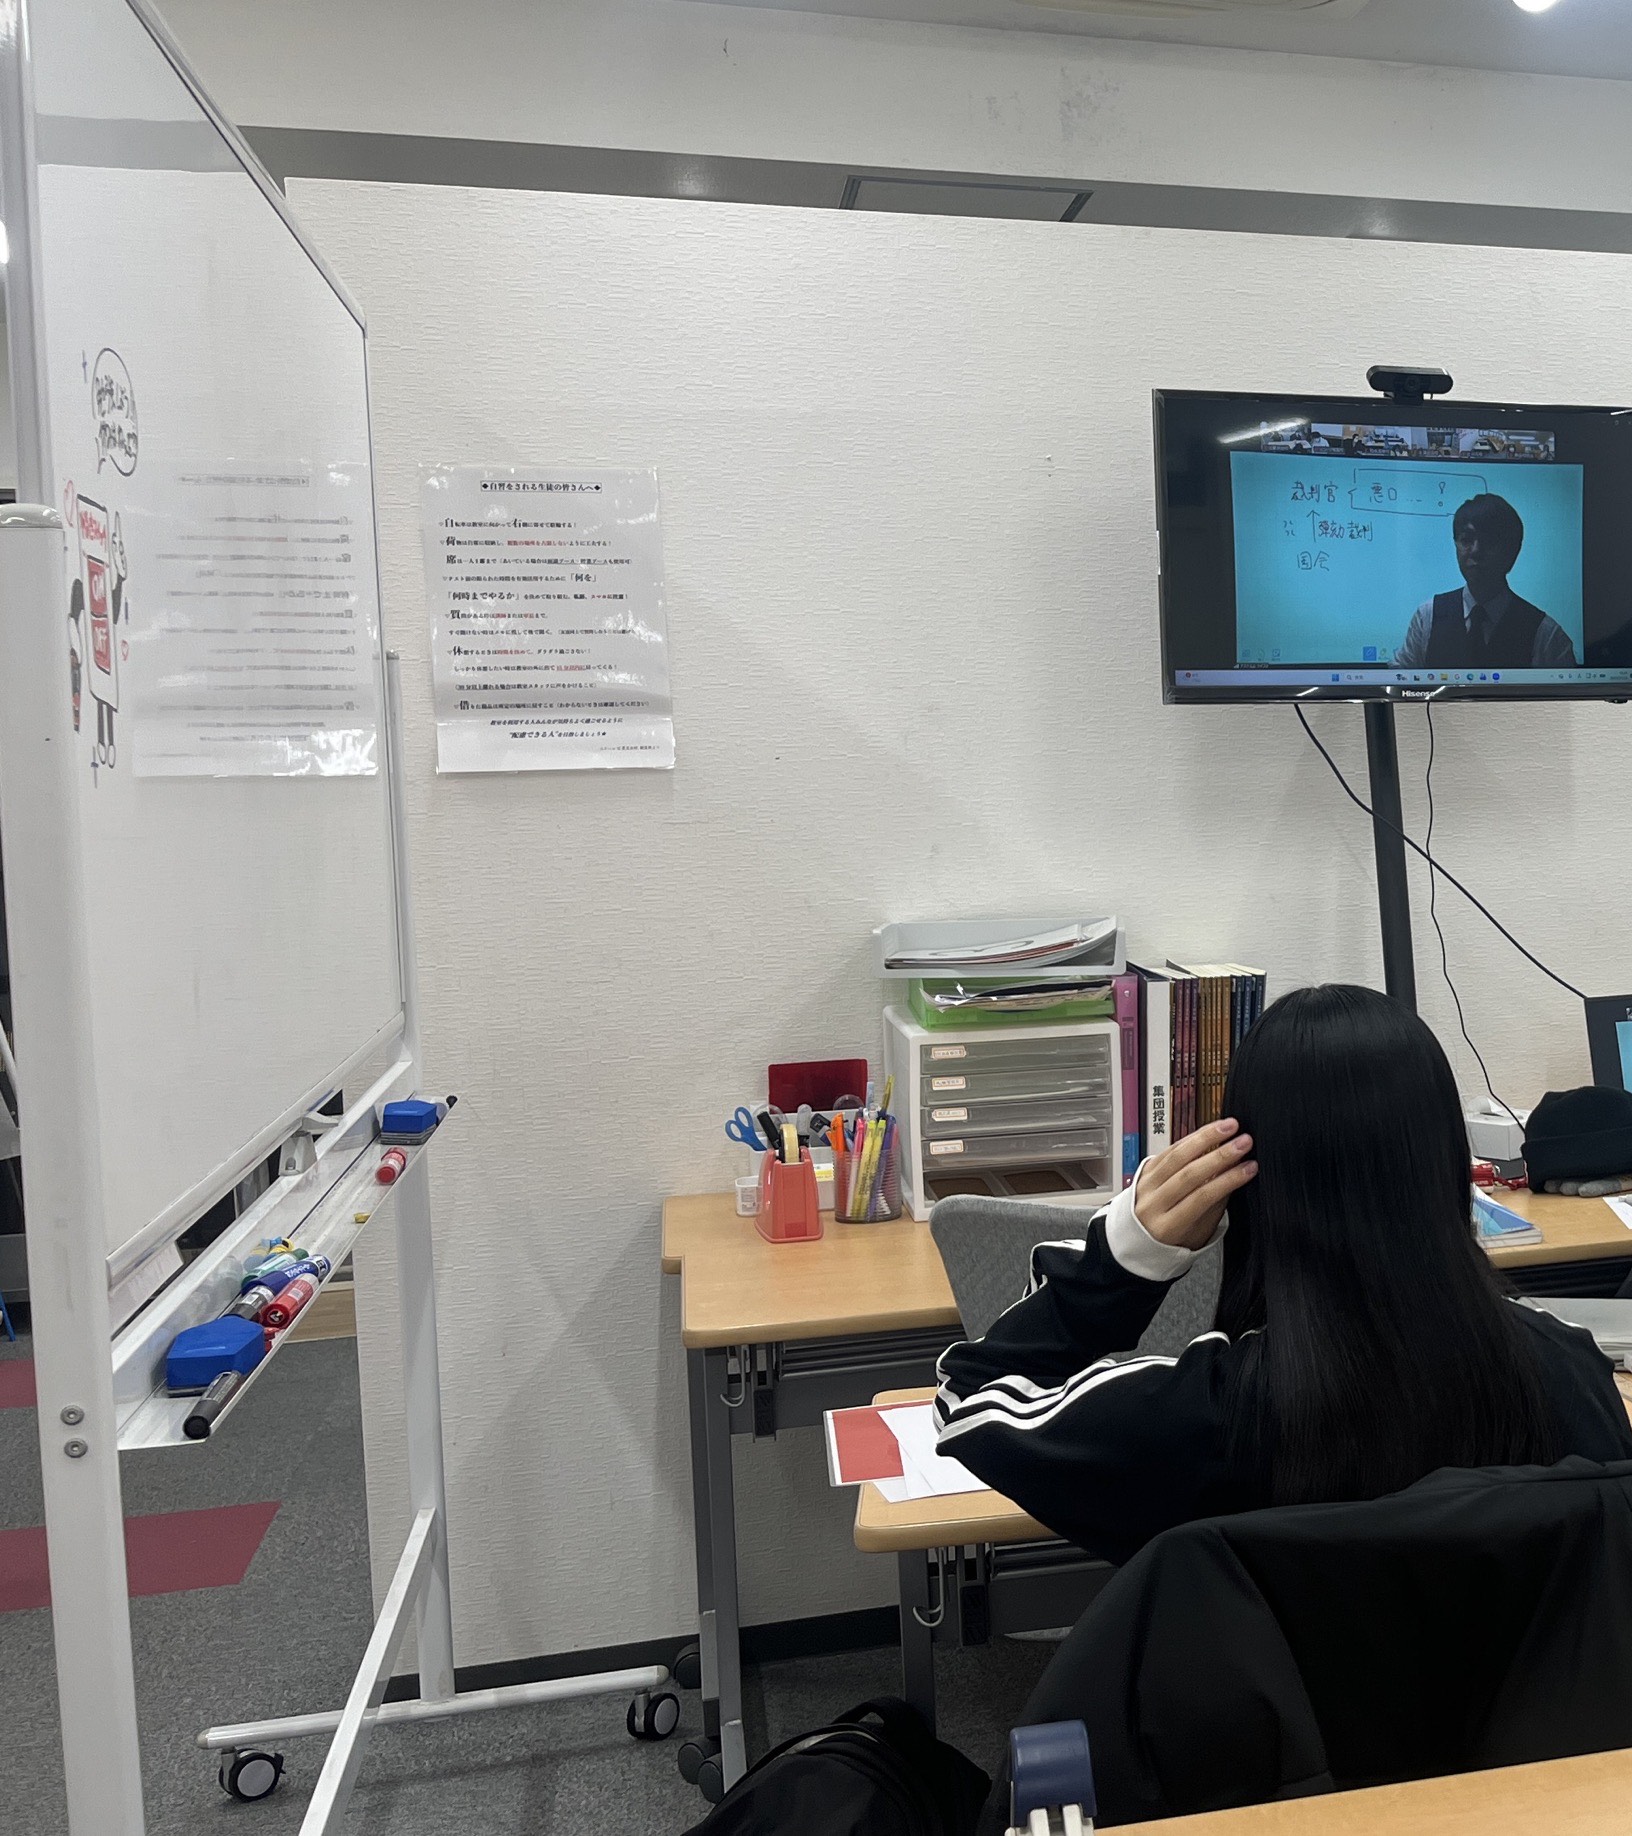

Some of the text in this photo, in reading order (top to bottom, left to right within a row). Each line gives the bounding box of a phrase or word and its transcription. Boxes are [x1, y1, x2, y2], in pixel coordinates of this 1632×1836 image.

[1291, 480, 1339, 503] 裁判官
[1402, 689, 1436, 698] Hisense
[1152, 1085, 1165, 1135] 集団授業
